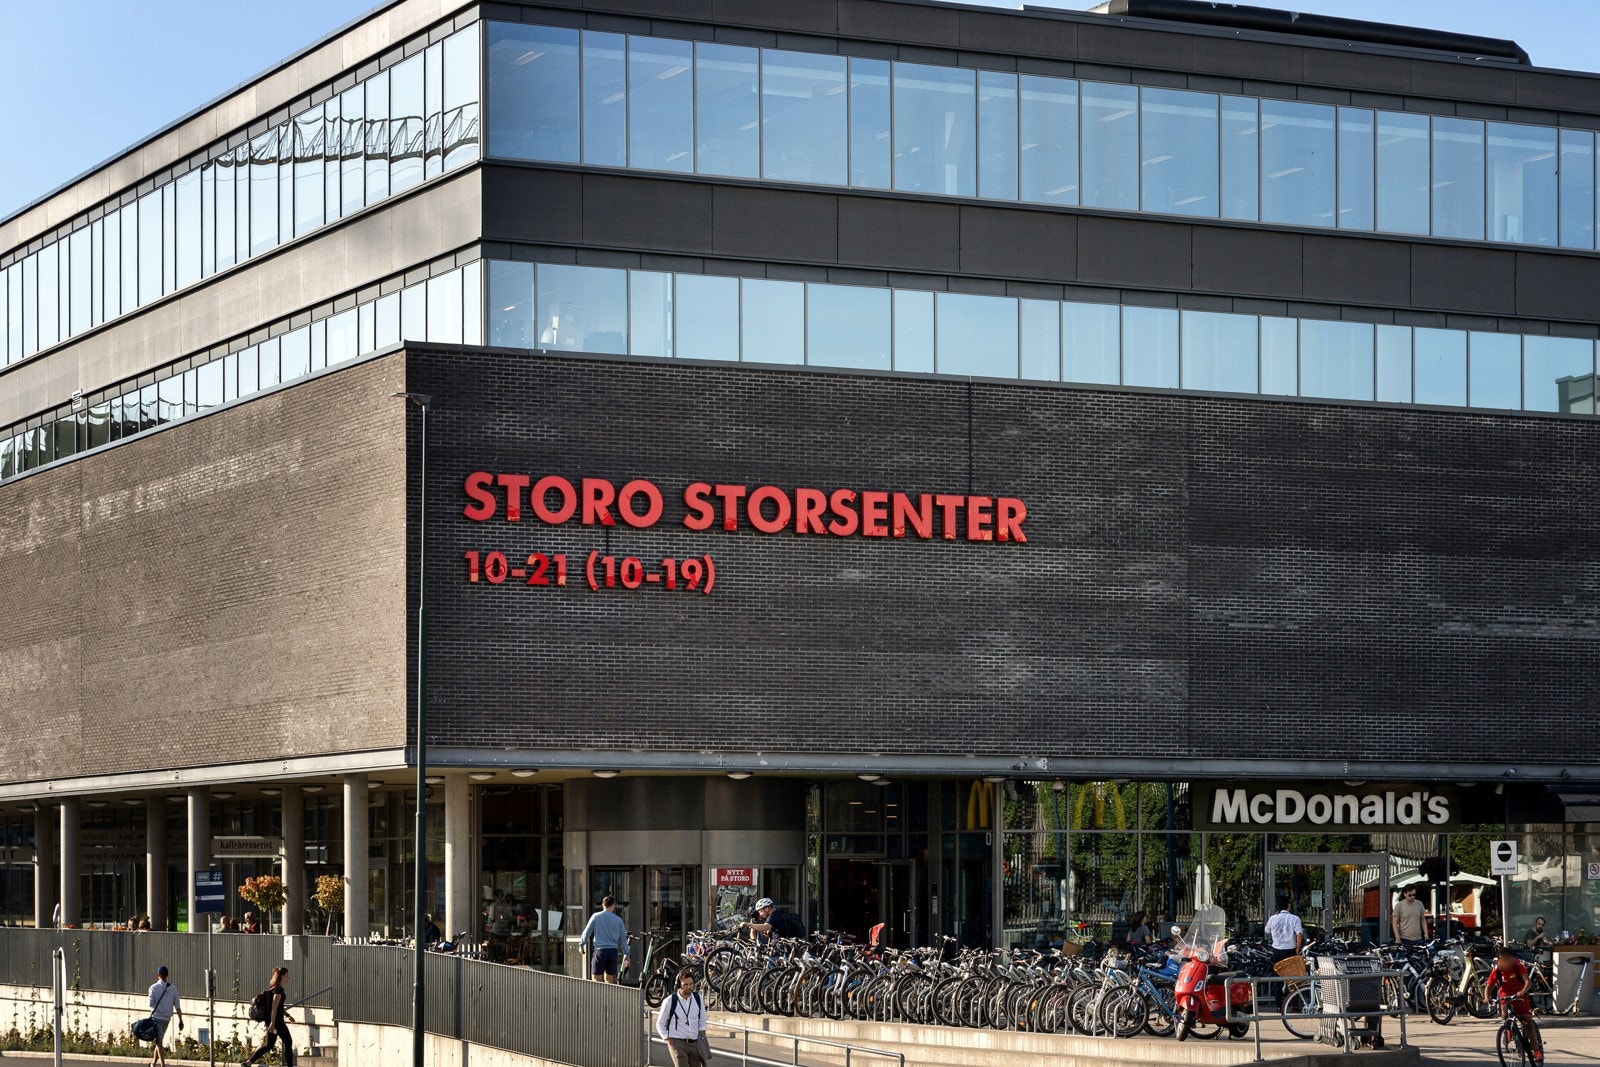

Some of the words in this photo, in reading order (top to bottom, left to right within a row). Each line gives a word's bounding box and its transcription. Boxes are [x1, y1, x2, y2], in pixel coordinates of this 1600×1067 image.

[462, 471, 664, 530] STORO
[682, 483, 1029, 544] STORSENTER
[464, 550, 568, 586] 10-21
[585, 550, 716, 595] (10-19)
[1211, 788, 1450, 825] McDonald's
